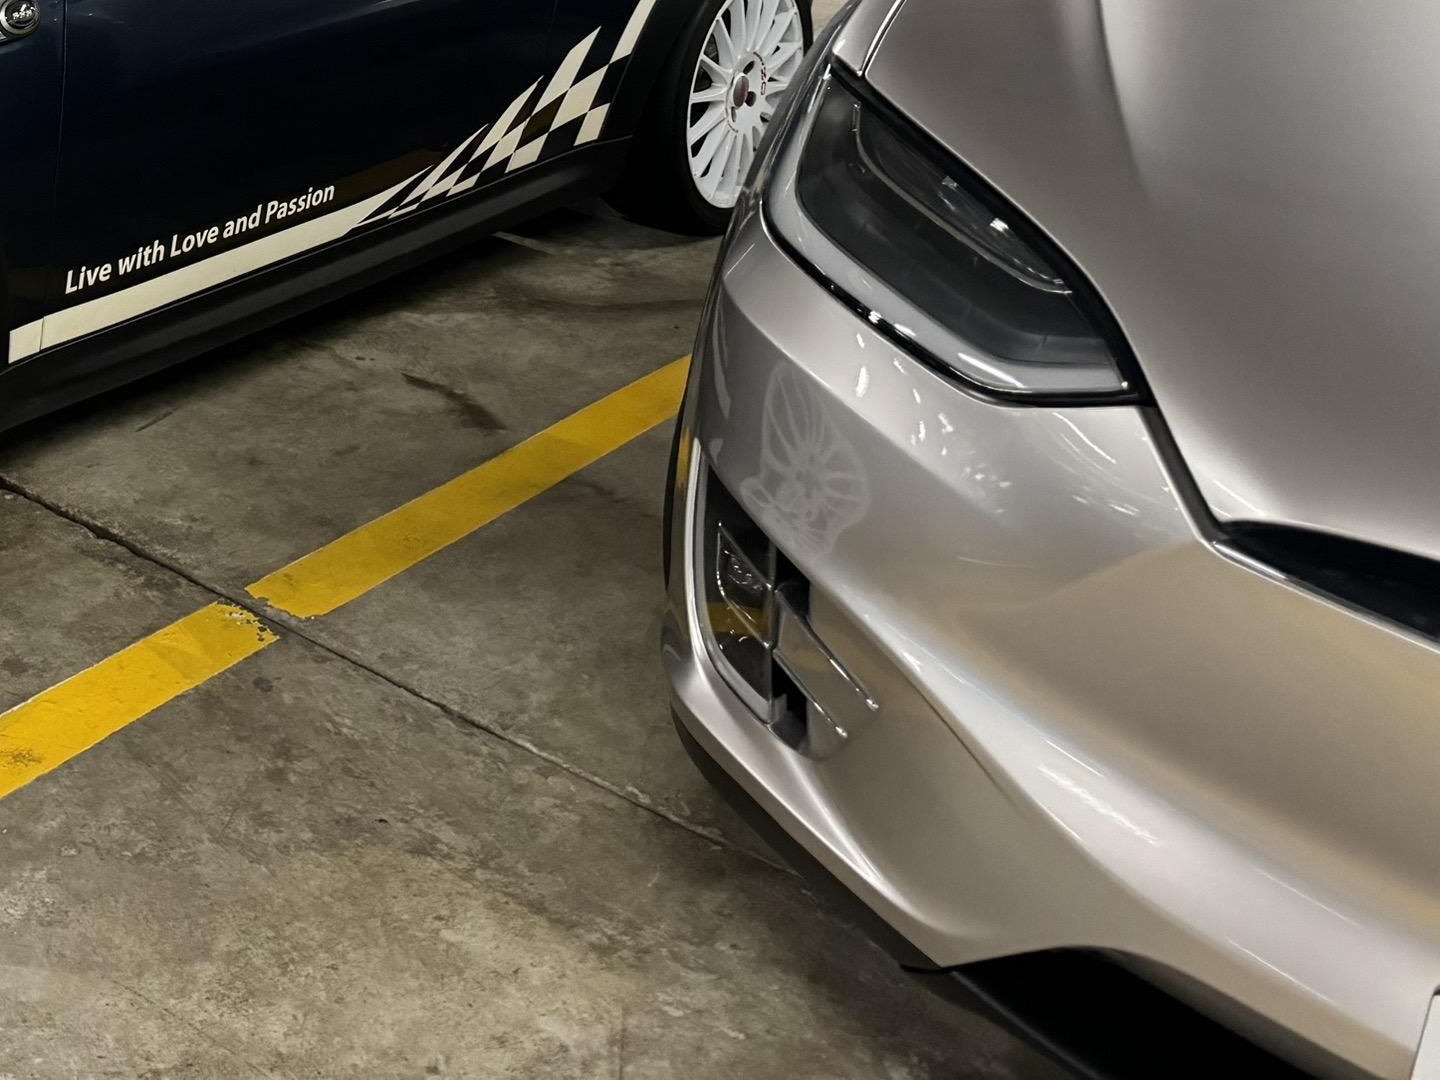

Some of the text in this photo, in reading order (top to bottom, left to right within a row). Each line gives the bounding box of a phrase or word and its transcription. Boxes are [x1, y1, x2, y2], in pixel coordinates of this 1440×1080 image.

[65, 184, 336, 295] Live with Love and Passion
